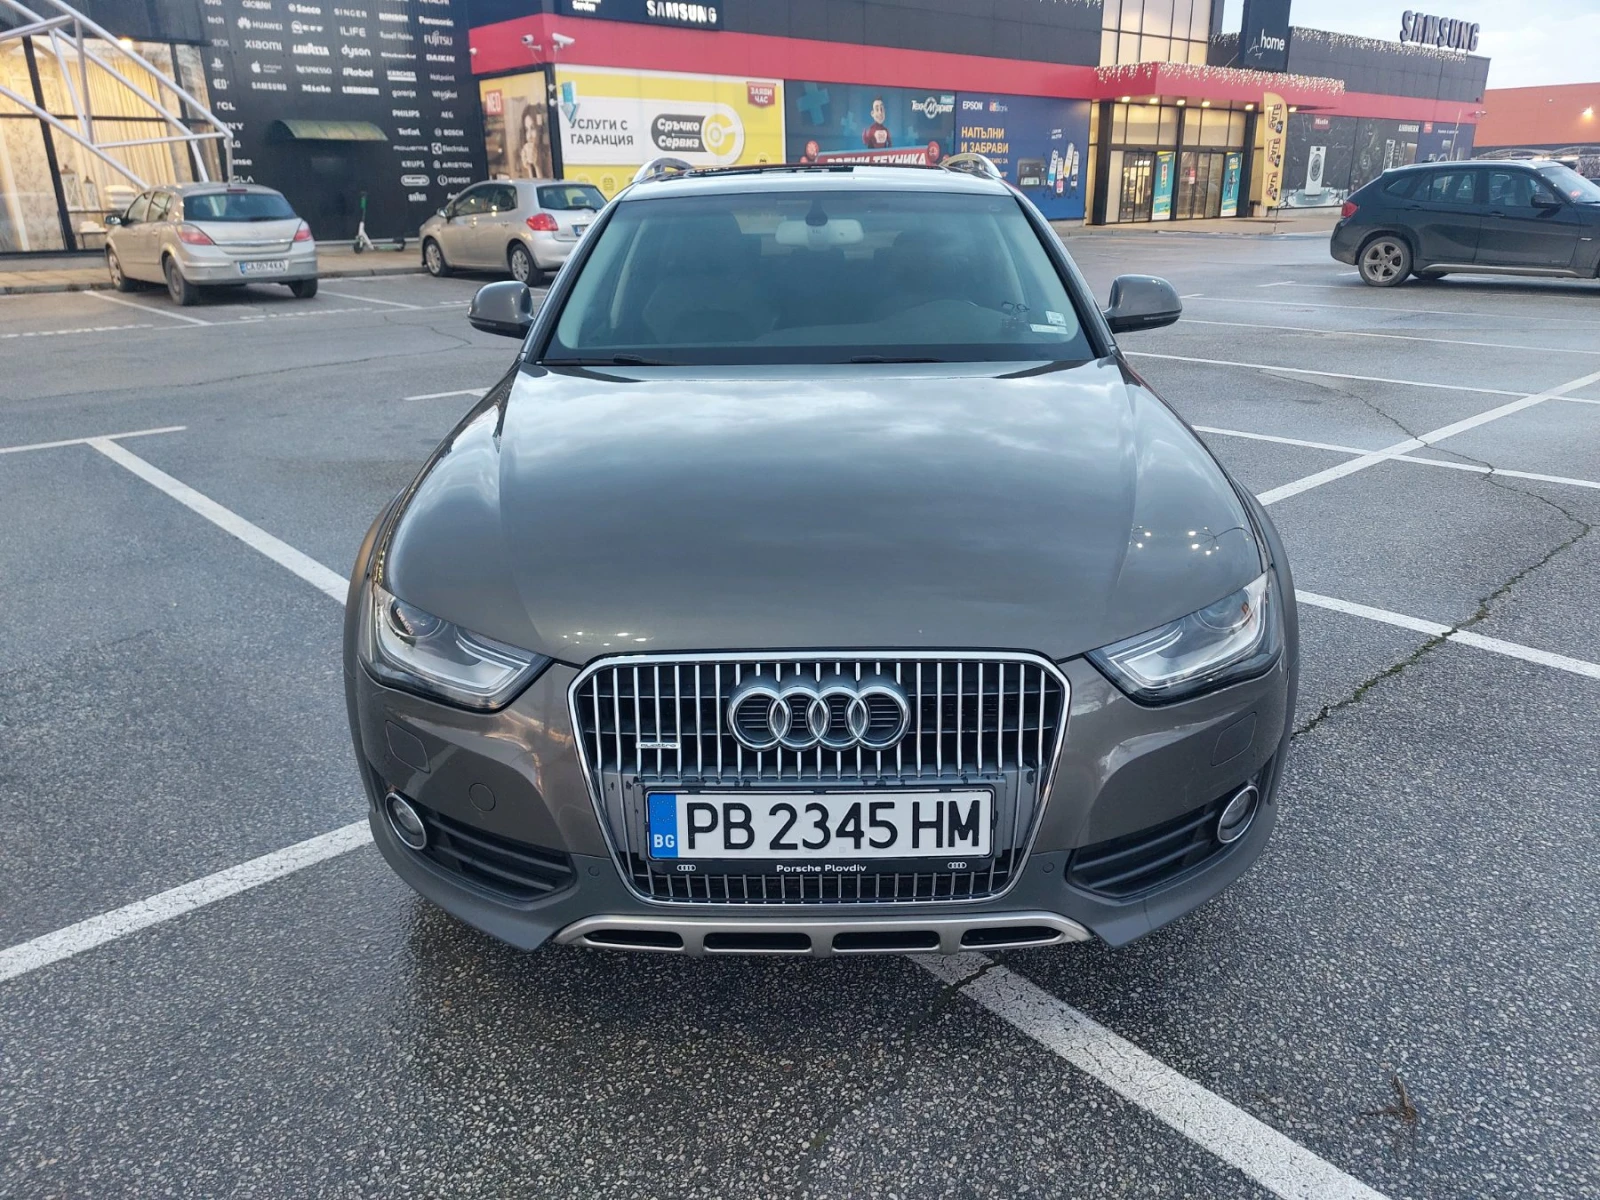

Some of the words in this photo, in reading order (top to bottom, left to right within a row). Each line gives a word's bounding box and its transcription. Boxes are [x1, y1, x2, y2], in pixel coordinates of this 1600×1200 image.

[334, 8, 367, 18] SINGER
[647, 1, 717, 24] SAMSUNG
[252, 21, 283, 31] HUAWEI
[418, 16, 454, 26] Panasonic
[1400, 10, 1480, 52] SAMSUNG
[424, 31, 453, 47] FUJITSU
[1260, 28, 1286, 52] home
[293, 43, 330, 56] LAVAZZA
[341, 44, 372, 58] dyson
[426, 54, 456, 63] DAIKIN
[296, 65, 333, 75] NESPRESSO
[252, 82, 288, 91] SAMSUNG
[302, 84, 332, 93] Miele
[750, 86, 773, 96] ЗАЯВИ
[754, 95, 769, 104] ЧАС
[962, 101, 983, 111] EPSON
[392, 110, 421, 118] PHILIPS
[570, 118, 617, 131] УСЛУГИ
[657, 118, 700, 132] Сръчко
[443, 129, 464, 137] BOSCH
[961, 127, 1005, 140] НАПЪЛНИ
[570, 134, 634, 146] ГАРАНЦИЯ
[658, 135, 700, 149] Сервиз
[961, 142, 967, 154] И
[969, 143, 1009, 155] ЗАБРАВИ
[401, 161, 426, 169] KRUPS
[686, 802, 755, 850] PB
[768, 801, 898, 850] 2345
[912, 800, 981, 849] HM
[653, 834, 675, 848] BG
[776, 864, 822, 873] Porsche
[824, 864, 867, 873] Plovdiv
